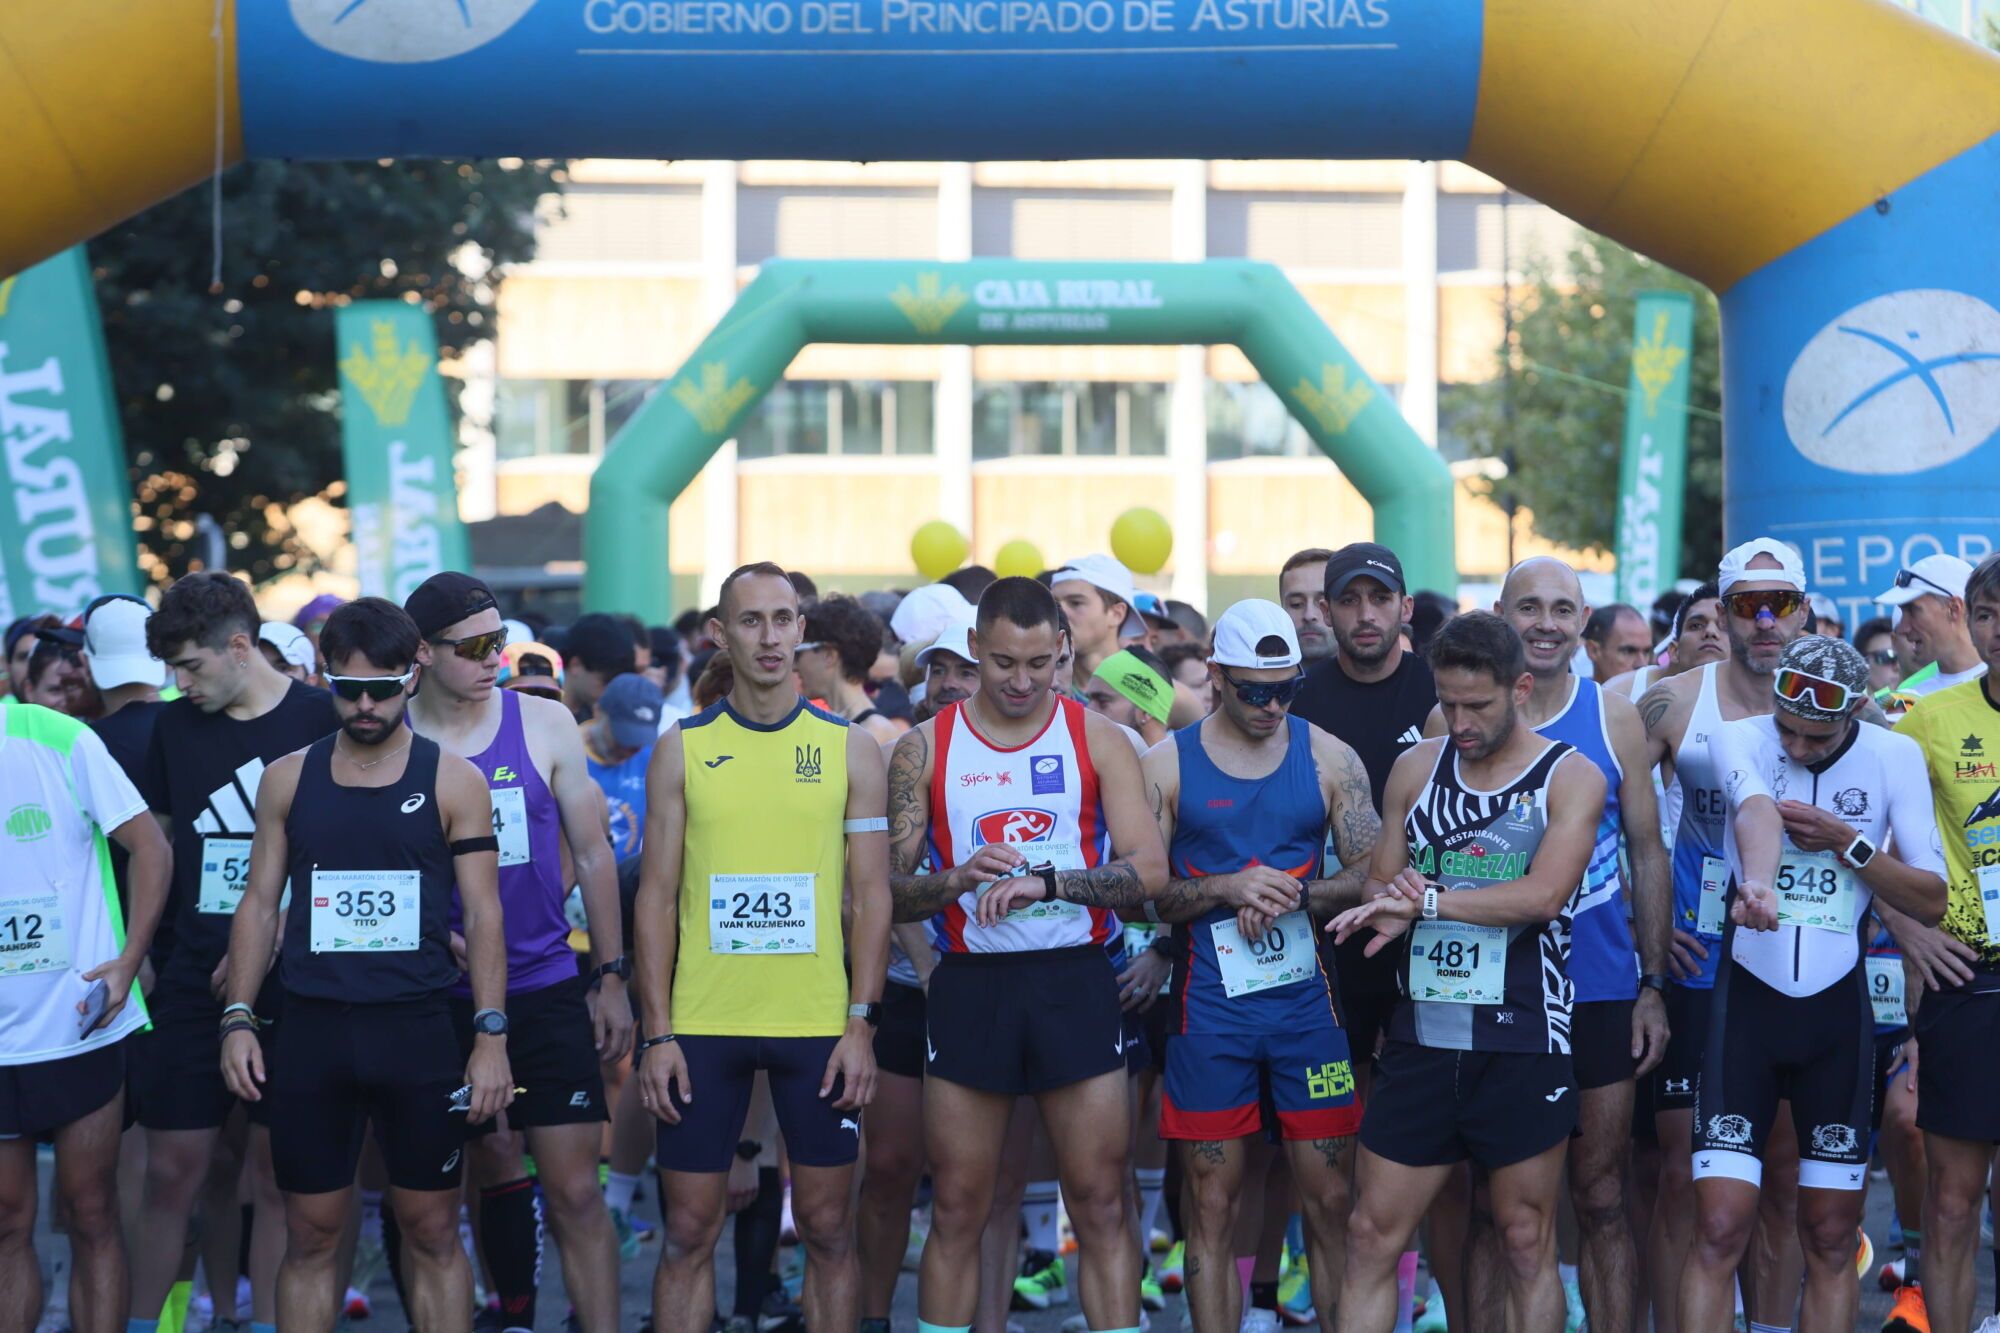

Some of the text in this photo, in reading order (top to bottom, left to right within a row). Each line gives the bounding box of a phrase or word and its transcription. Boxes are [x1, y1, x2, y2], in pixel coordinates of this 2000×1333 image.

[583, 0, 1389, 34] GOBIERNO DEL PRINCIPADO DE ASTURIAS
[975, 280, 1164, 309] CAJA RURAL
[1789, 531, 1994, 586] EPOR
[960, 772, 992, 787] gijón
[1444, 829, 1511, 851] RESTAURANTE
[1777, 865, 1837, 895] 548
[335, 890, 396, 917] 353
[732, 892, 792, 919] 243
[1784, 892, 1828, 904] RUFIANI
[0, 913, 44, 942] 12
[352, 918, 379, 927] TITO
[719, 919, 806, 929] IVAN KUZMENKO
[1256, 953, 1285, 966] KAKO
[1427, 939, 1480, 970] 481
[1436, 968, 1471, 978] ROMEO
[1308, 1073, 1355, 1099] OCR
